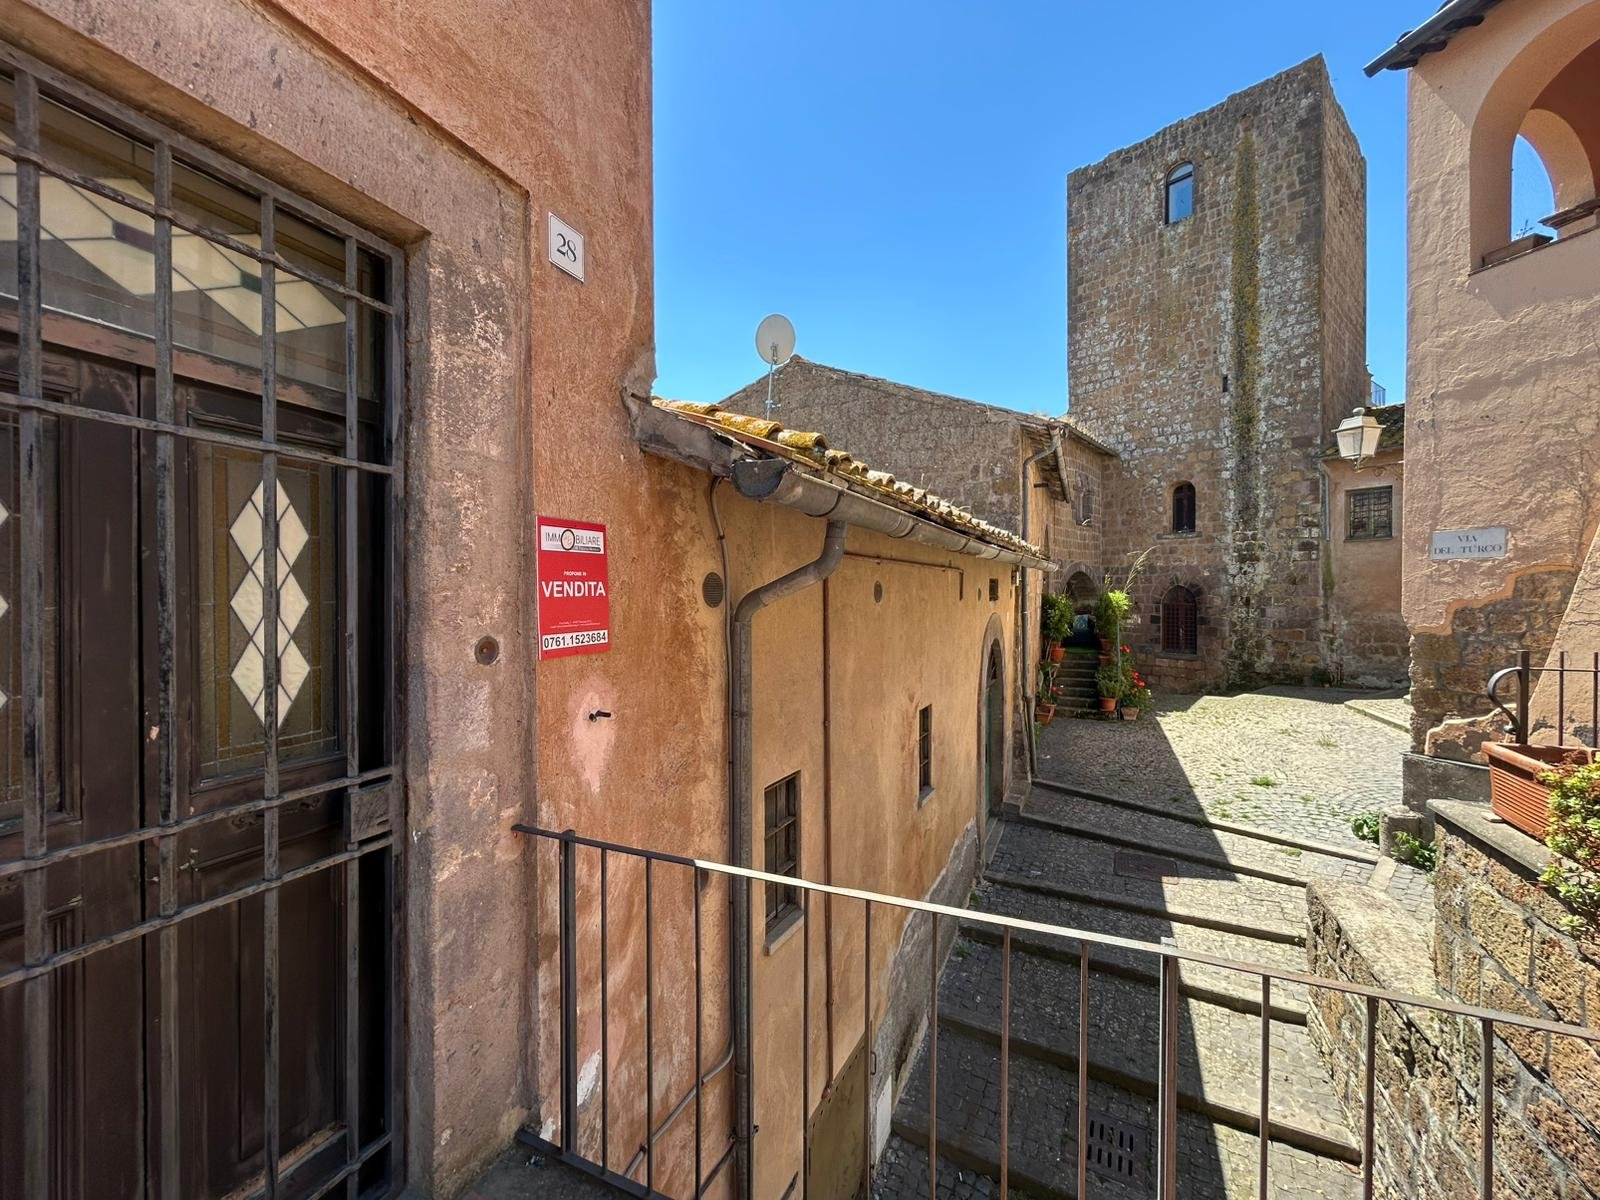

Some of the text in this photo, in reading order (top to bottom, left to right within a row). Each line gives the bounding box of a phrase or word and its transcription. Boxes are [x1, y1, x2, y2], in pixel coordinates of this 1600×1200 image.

[556, 232, 577, 263] 28
[545, 529, 601, 551] IMMOBILIARE
[1434, 544, 1502, 555] DEL TURCO
[541, 581, 606, 598] VENDITA
[543, 632, 607, 649] 0761.1523684
